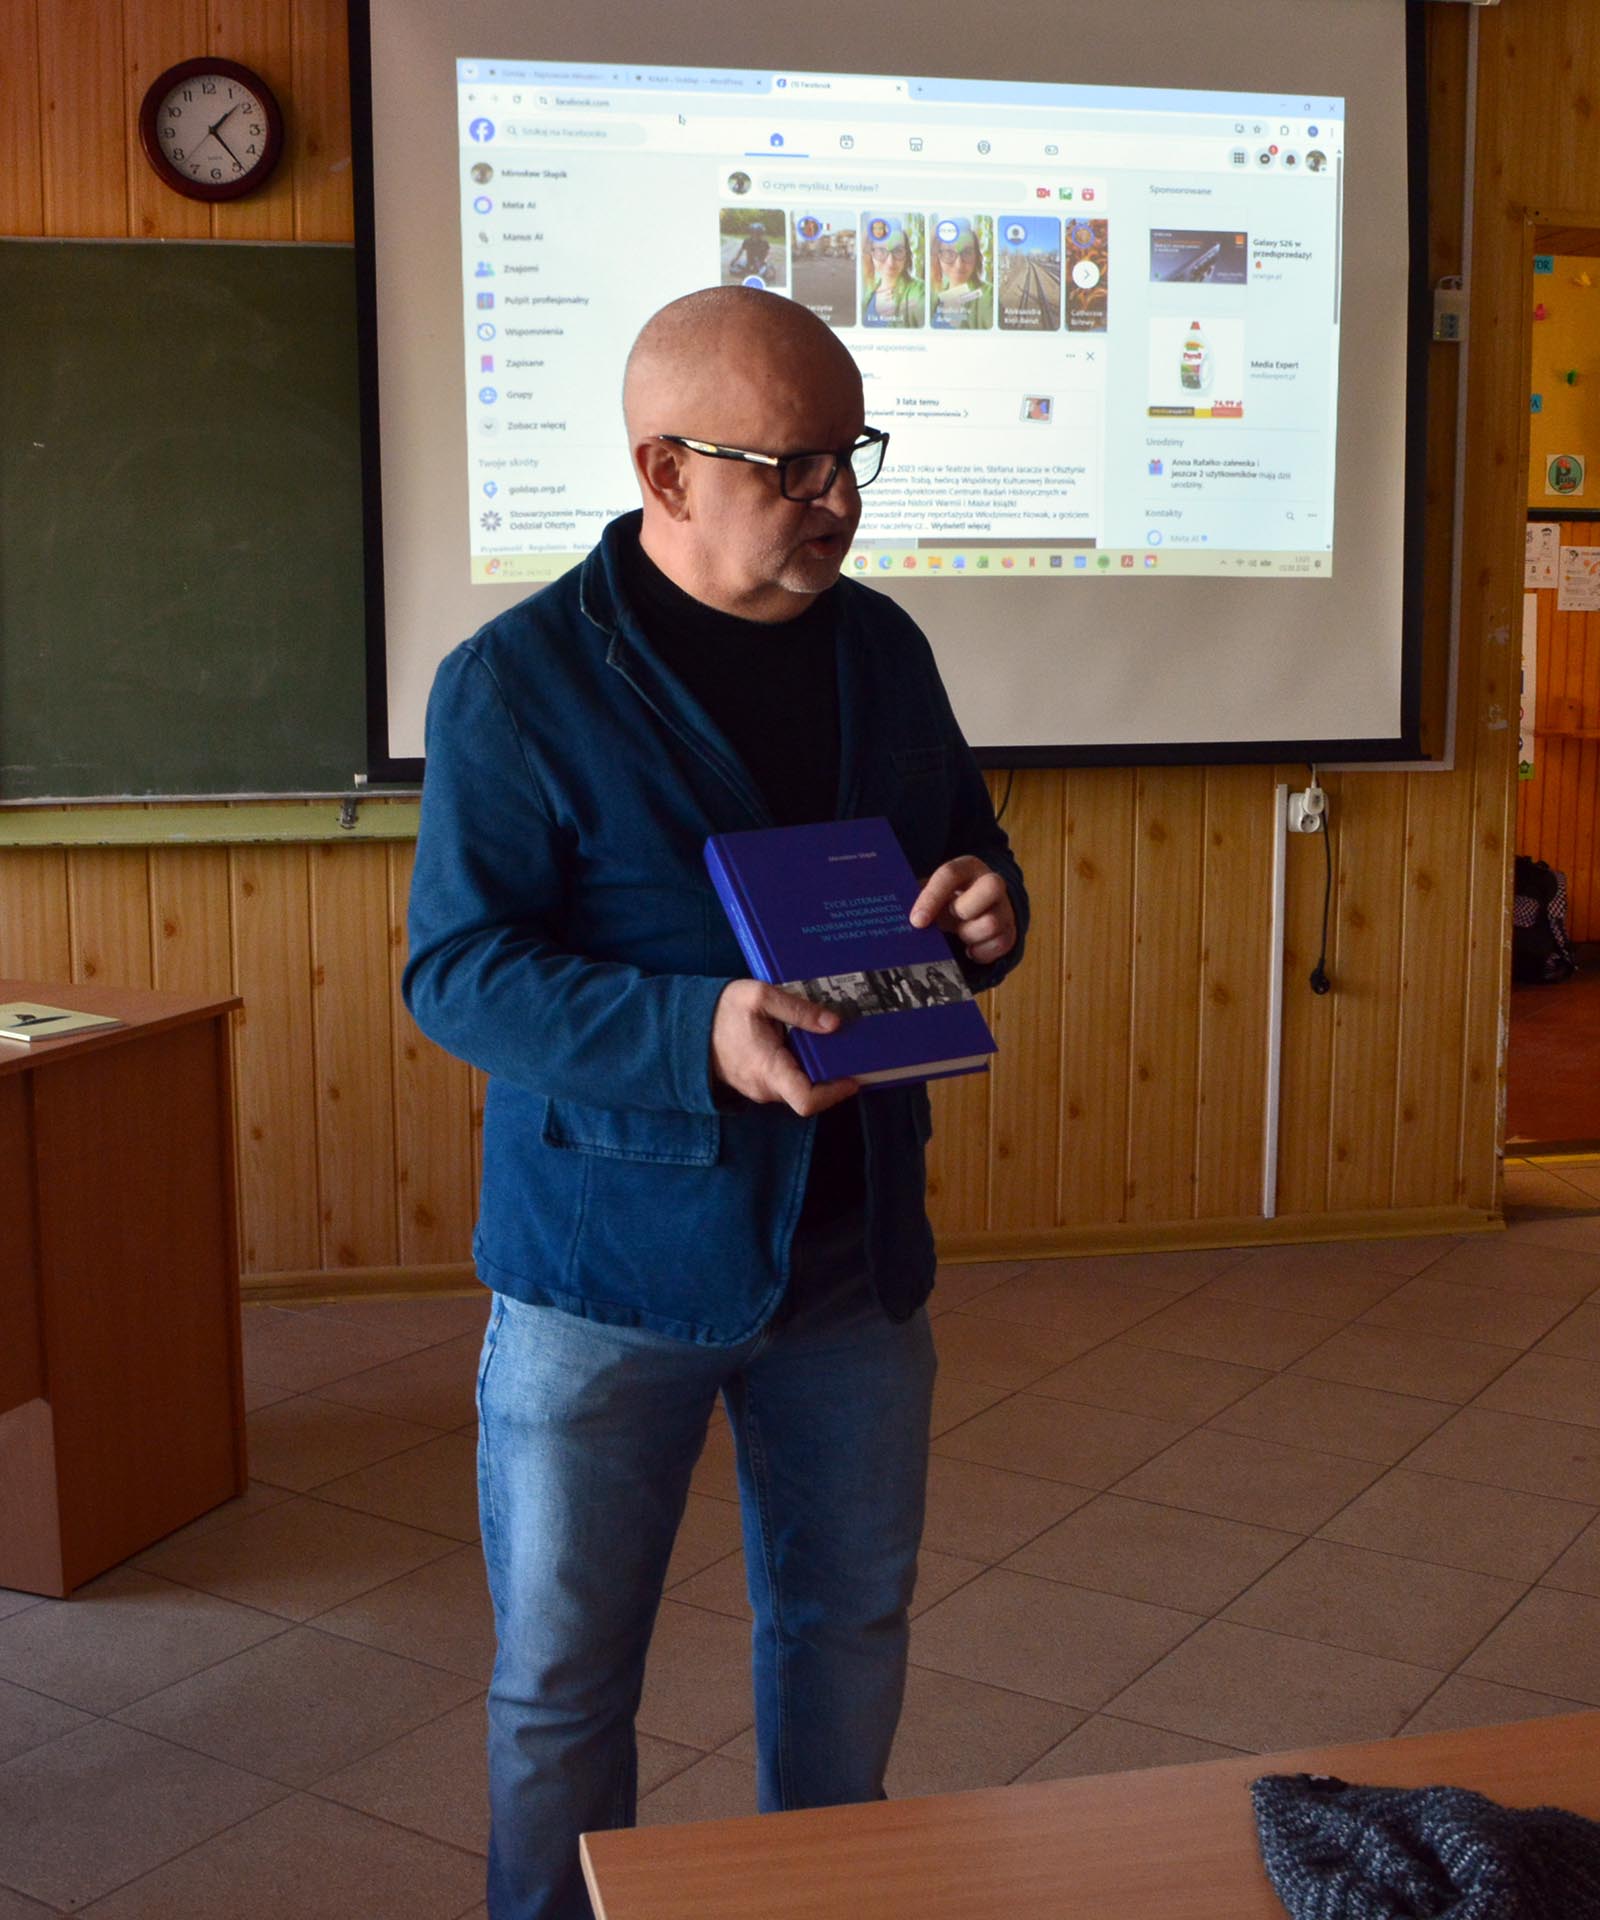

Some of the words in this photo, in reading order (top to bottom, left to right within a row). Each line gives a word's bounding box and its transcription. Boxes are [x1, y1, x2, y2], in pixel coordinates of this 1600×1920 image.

[202, 83, 216, 94] 12
[800, 82, 831, 91] Facebook
[183, 91, 192, 102] 11
[228, 88, 233, 99] 1
[168, 107, 182, 118] 10
[242, 103, 252, 114] 2
[164, 127, 176, 138] 9
[250, 124, 261, 136] 3
[173, 148, 184, 161] 8
[246, 144, 256, 155] 4
[190, 164, 200, 175] 7
[232, 163, 242, 173] 5
[210, 168, 222, 180] 6
[763, 181, 770, 190] O
[773, 182, 796, 192] czym
[1150, 185, 1211, 196] Sponsorowane
[502, 200, 525, 211] Meta
[527, 200, 536, 210] AI
[534, 232, 543, 242] AI
[1253, 238, 1278, 249] Galaxy
[1279, 239, 1293, 248] S26
[1253, 249, 1313, 261] przedsprzedaży!
[504, 263, 539, 275] Znajomi
[504, 295, 529, 308] Pulpit
[532, 295, 589, 308] profesjonalny
[504, 327, 564, 339] Wspomnienia
[505, 358, 545, 370] Zapisane
[1251, 361, 1274, 370] Media
[1276, 361, 1299, 372] Expert
[506, 391, 533, 401] Grupy
[902, 397, 917, 406] lata
[919, 398, 940, 406] temu
[507, 420, 538, 431] Zobacz
[540, 420, 567, 433] więcej
[1146, 438, 1184, 449] Urodziny
[478, 458, 507, 471] Twoje
[509, 457, 539, 470] skróty
[1172, 458, 1191, 467] Anna
[897, 464, 916, 473] 2023
[917, 464, 935, 473] roku
[945, 464, 972, 473] Teatrze
[986, 464, 1014, 473] Stefana
[1052, 465, 1085, 476] Olsztynie
[961, 475, 1001, 486] Wspólnoty
[1003, 476, 1042, 487] Kulturowej
[1171, 470, 1197, 480] jeszcze
[1205, 470, 1257, 481] użytkowników
[1259, 472, 1276, 482] mają
[1171, 481, 1203, 490] urodziny.
[903, 487, 947, 498] dyrektorem
[949, 487, 980, 496] Centrum
[982, 487, 1006, 496] Badań
[1008, 488, 1060, 498] Historycznych
[936, 498, 961, 507] Warmii
[968, 499, 990, 507] Mazur
[509, 509, 573, 521] Stowarzyszenie
[575, 508, 604, 520] Pisarzy
[864, 510, 902, 520] prowadził
[904, 511, 925, 520] znany
[927, 510, 973, 520] reportażysta
[976, 510, 1021, 519] Włodzimierz
[1023, 510, 1050, 520] Nowak,
[1059, 511, 1089, 522] gościem
[1145, 509, 1182, 519] Kontakty
[509, 520, 543, 532] Oddział
[544, 519, 577, 532] Olsztyn
[880, 521, 912, 532] naczelny
[931, 521, 965, 532] Wyświetl
[967, 521, 991, 532] więcej
